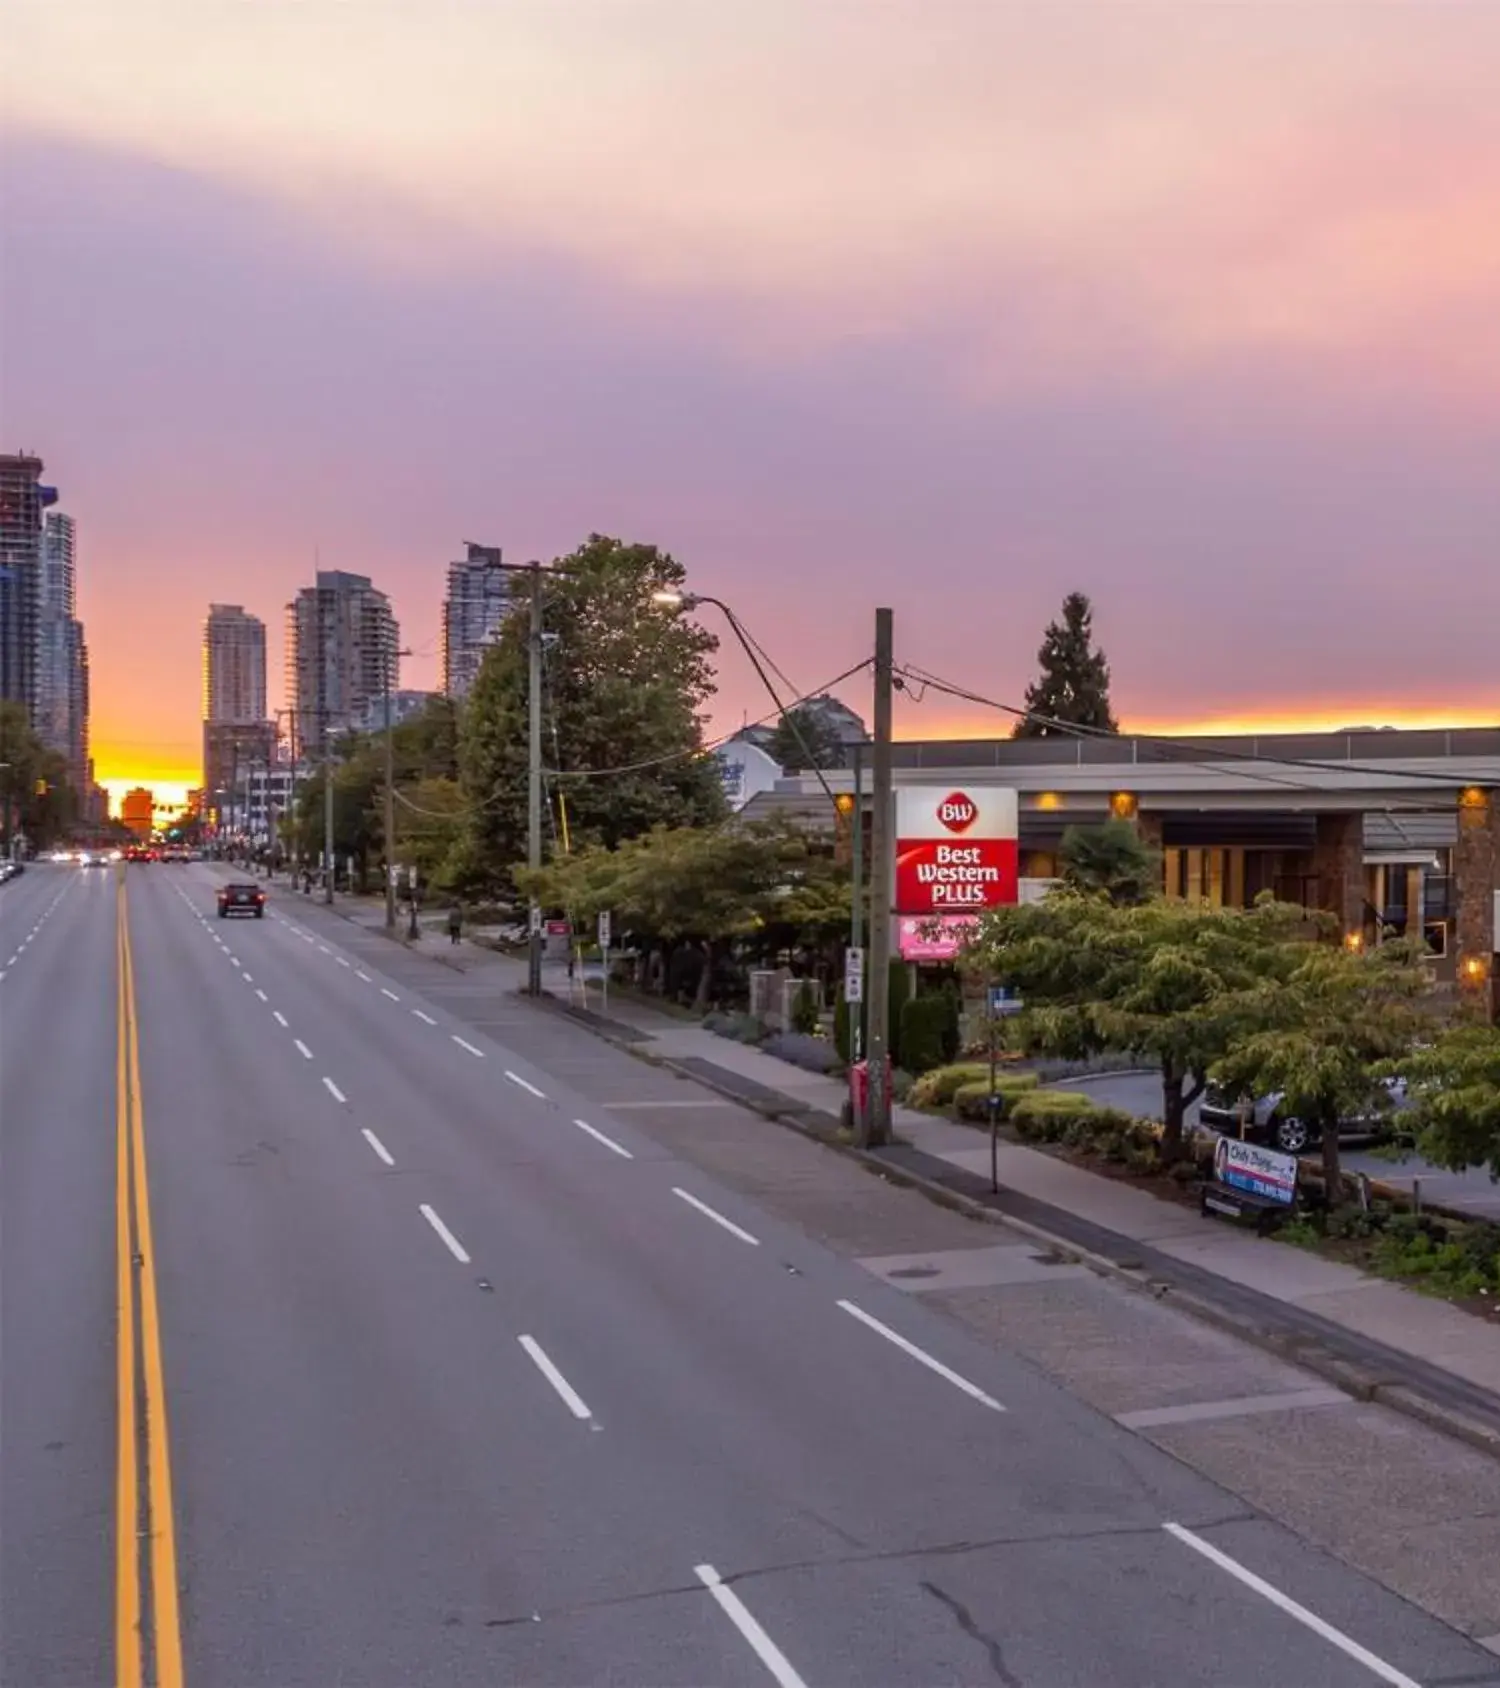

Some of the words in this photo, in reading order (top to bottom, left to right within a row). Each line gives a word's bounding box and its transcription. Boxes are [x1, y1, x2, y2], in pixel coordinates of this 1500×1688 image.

[942, 803, 973, 821] BW
[937, 845, 981, 863] Best
[917, 864, 998, 883] Western
